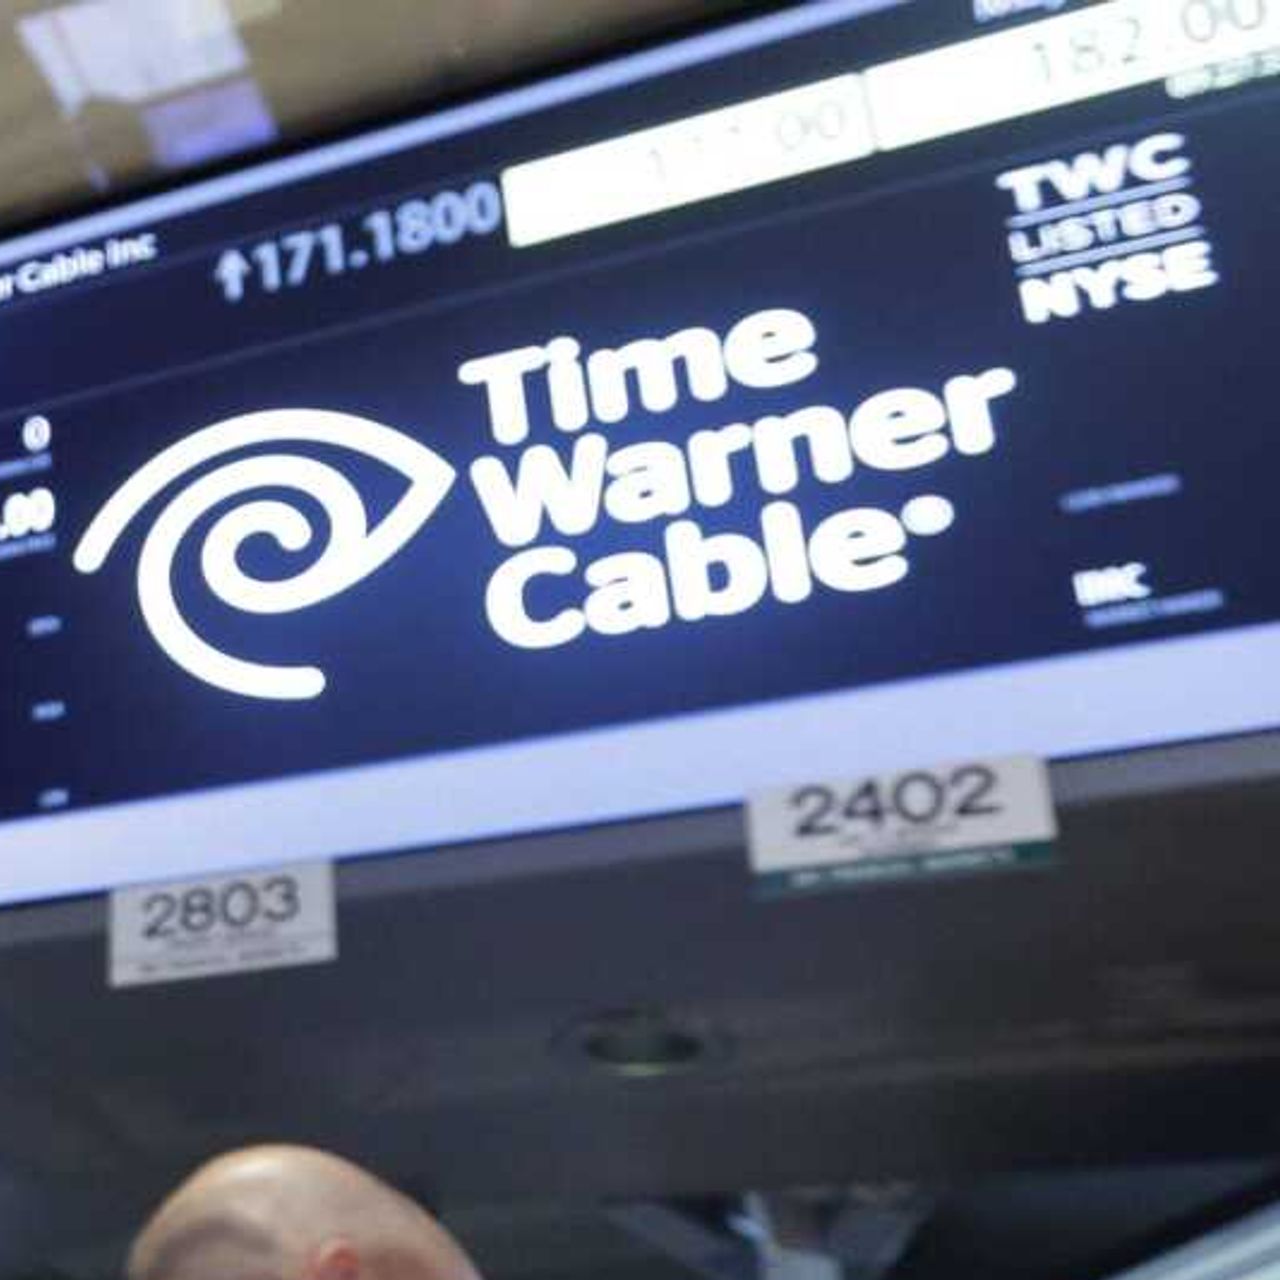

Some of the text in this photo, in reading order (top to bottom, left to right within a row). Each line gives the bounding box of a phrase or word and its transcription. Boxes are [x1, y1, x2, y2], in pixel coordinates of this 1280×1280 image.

[995, 132, 1192, 214] TWC
[250, 181, 502, 293] 171.1800
[1007, 193, 1203, 263] LISTED
[14, 249, 104, 293] Cable
[1018, 240, 1221, 325] NYSE
[456, 307, 819, 446] Time
[22, 414, 52, 452] 0
[469, 366, 1018, 548] Warner
[485, 499, 910, 650] Cable
[790, 762, 1002, 838] 2402
[140, 875, 301, 941] 2803
